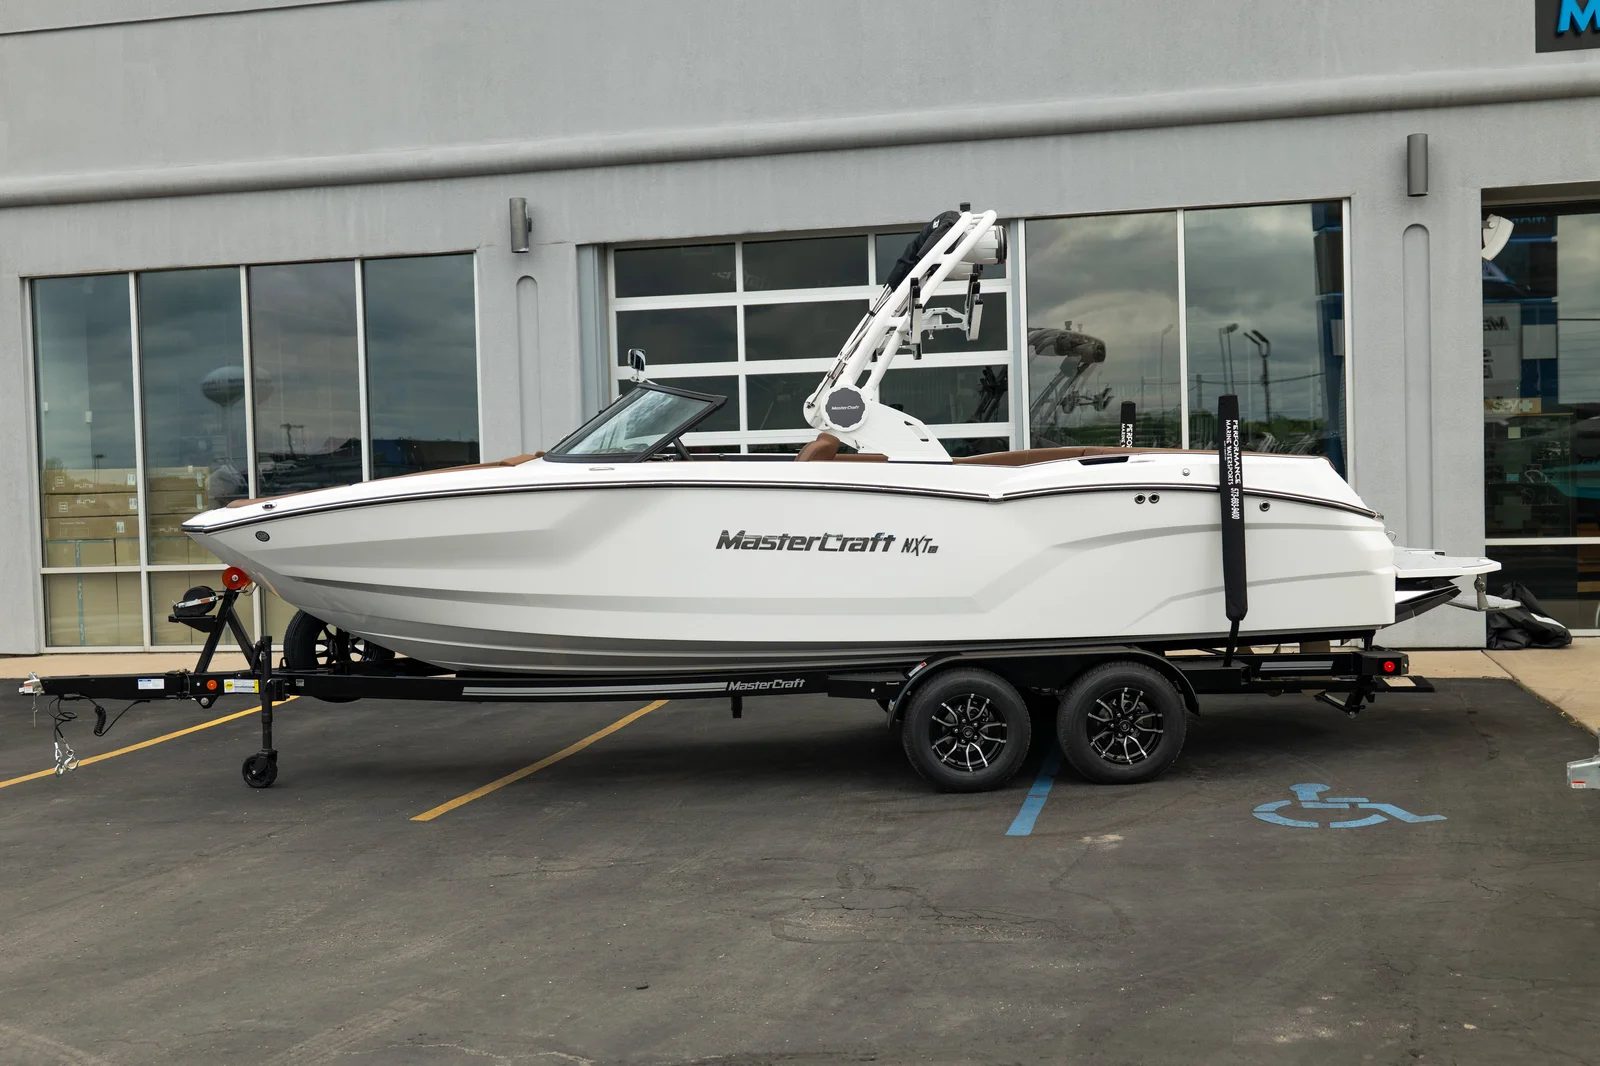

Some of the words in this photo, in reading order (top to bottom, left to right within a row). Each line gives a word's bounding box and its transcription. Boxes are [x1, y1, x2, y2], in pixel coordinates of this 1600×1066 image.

[1226, 445, 1234, 486] WATERSPORTS
[1232, 420, 1241, 485] PERFORMANCE
[716, 529, 896, 552] MasterCraft
[728, 678, 806, 691] MasterCraft
